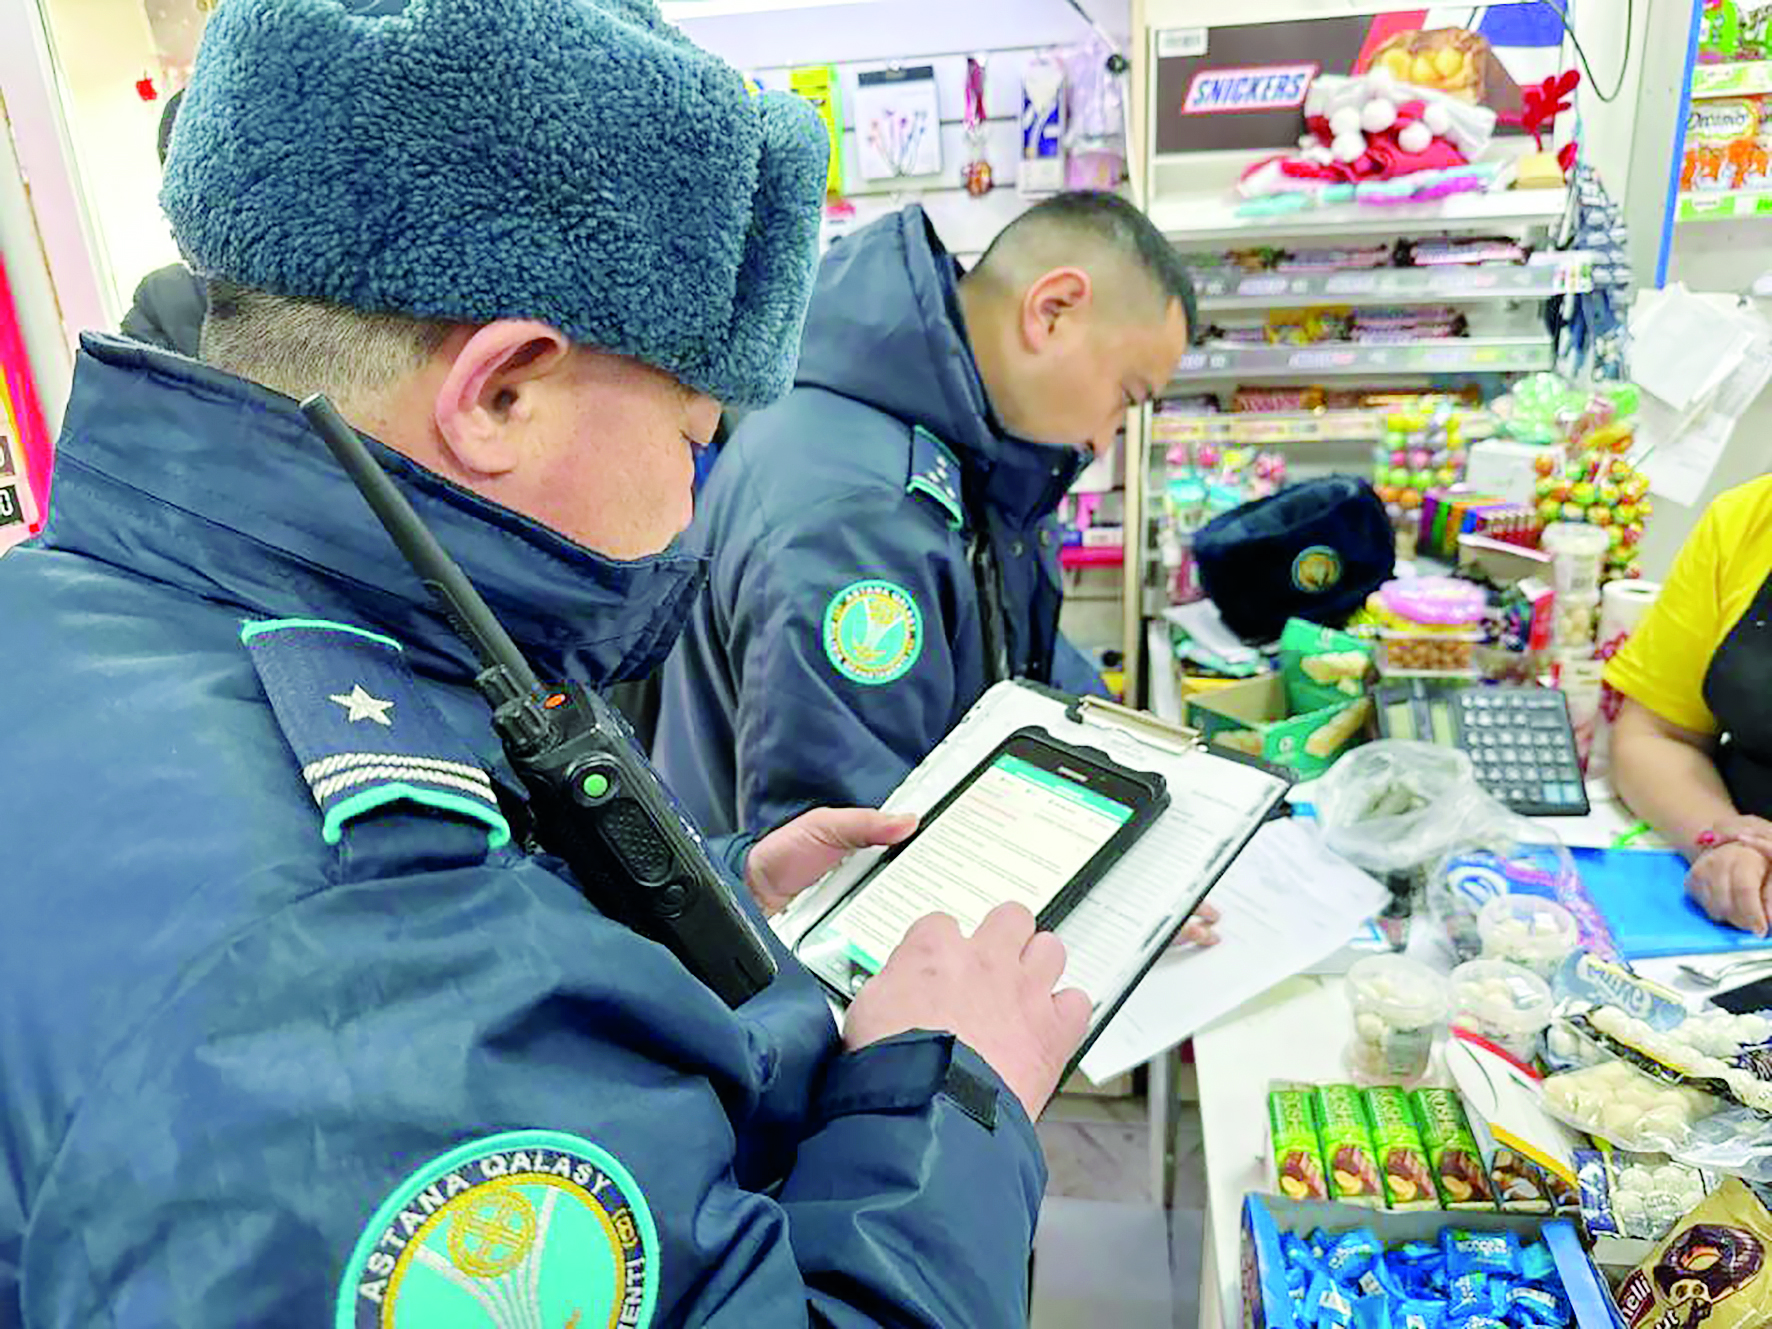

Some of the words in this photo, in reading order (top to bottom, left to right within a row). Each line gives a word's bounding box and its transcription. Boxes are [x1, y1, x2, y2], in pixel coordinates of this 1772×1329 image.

[1193, 73, 1306, 106] SNICKERS
[359, 1173, 470, 1304] ASTANA
[480, 1151, 612, 1196] QALASY
